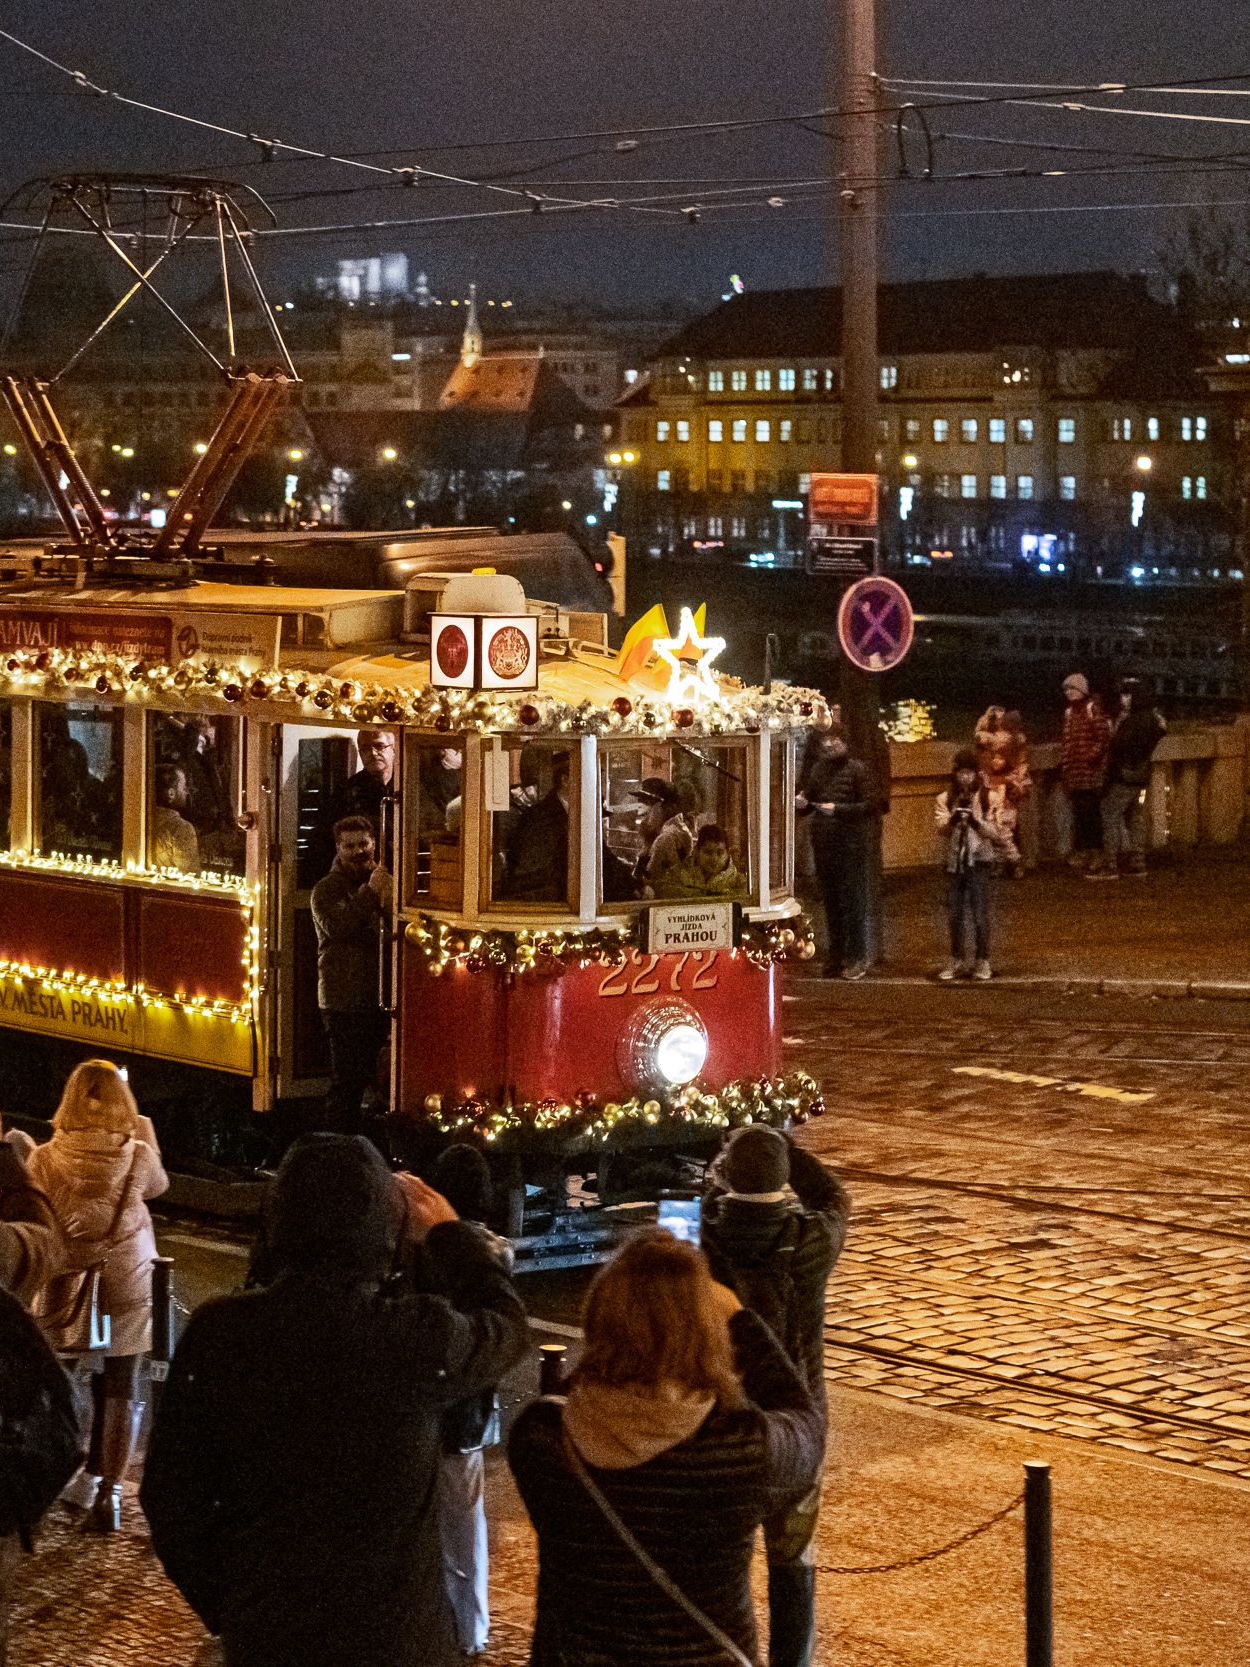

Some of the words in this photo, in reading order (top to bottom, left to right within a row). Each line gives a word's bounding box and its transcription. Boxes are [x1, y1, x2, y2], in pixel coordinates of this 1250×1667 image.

[667, 912, 716, 924] VYHLÍDKOVÁ
[664, 930, 718, 944] PRAHOU
[599, 949, 718, 996] 2272
[11, 984, 67, 1021] MĚSTA
